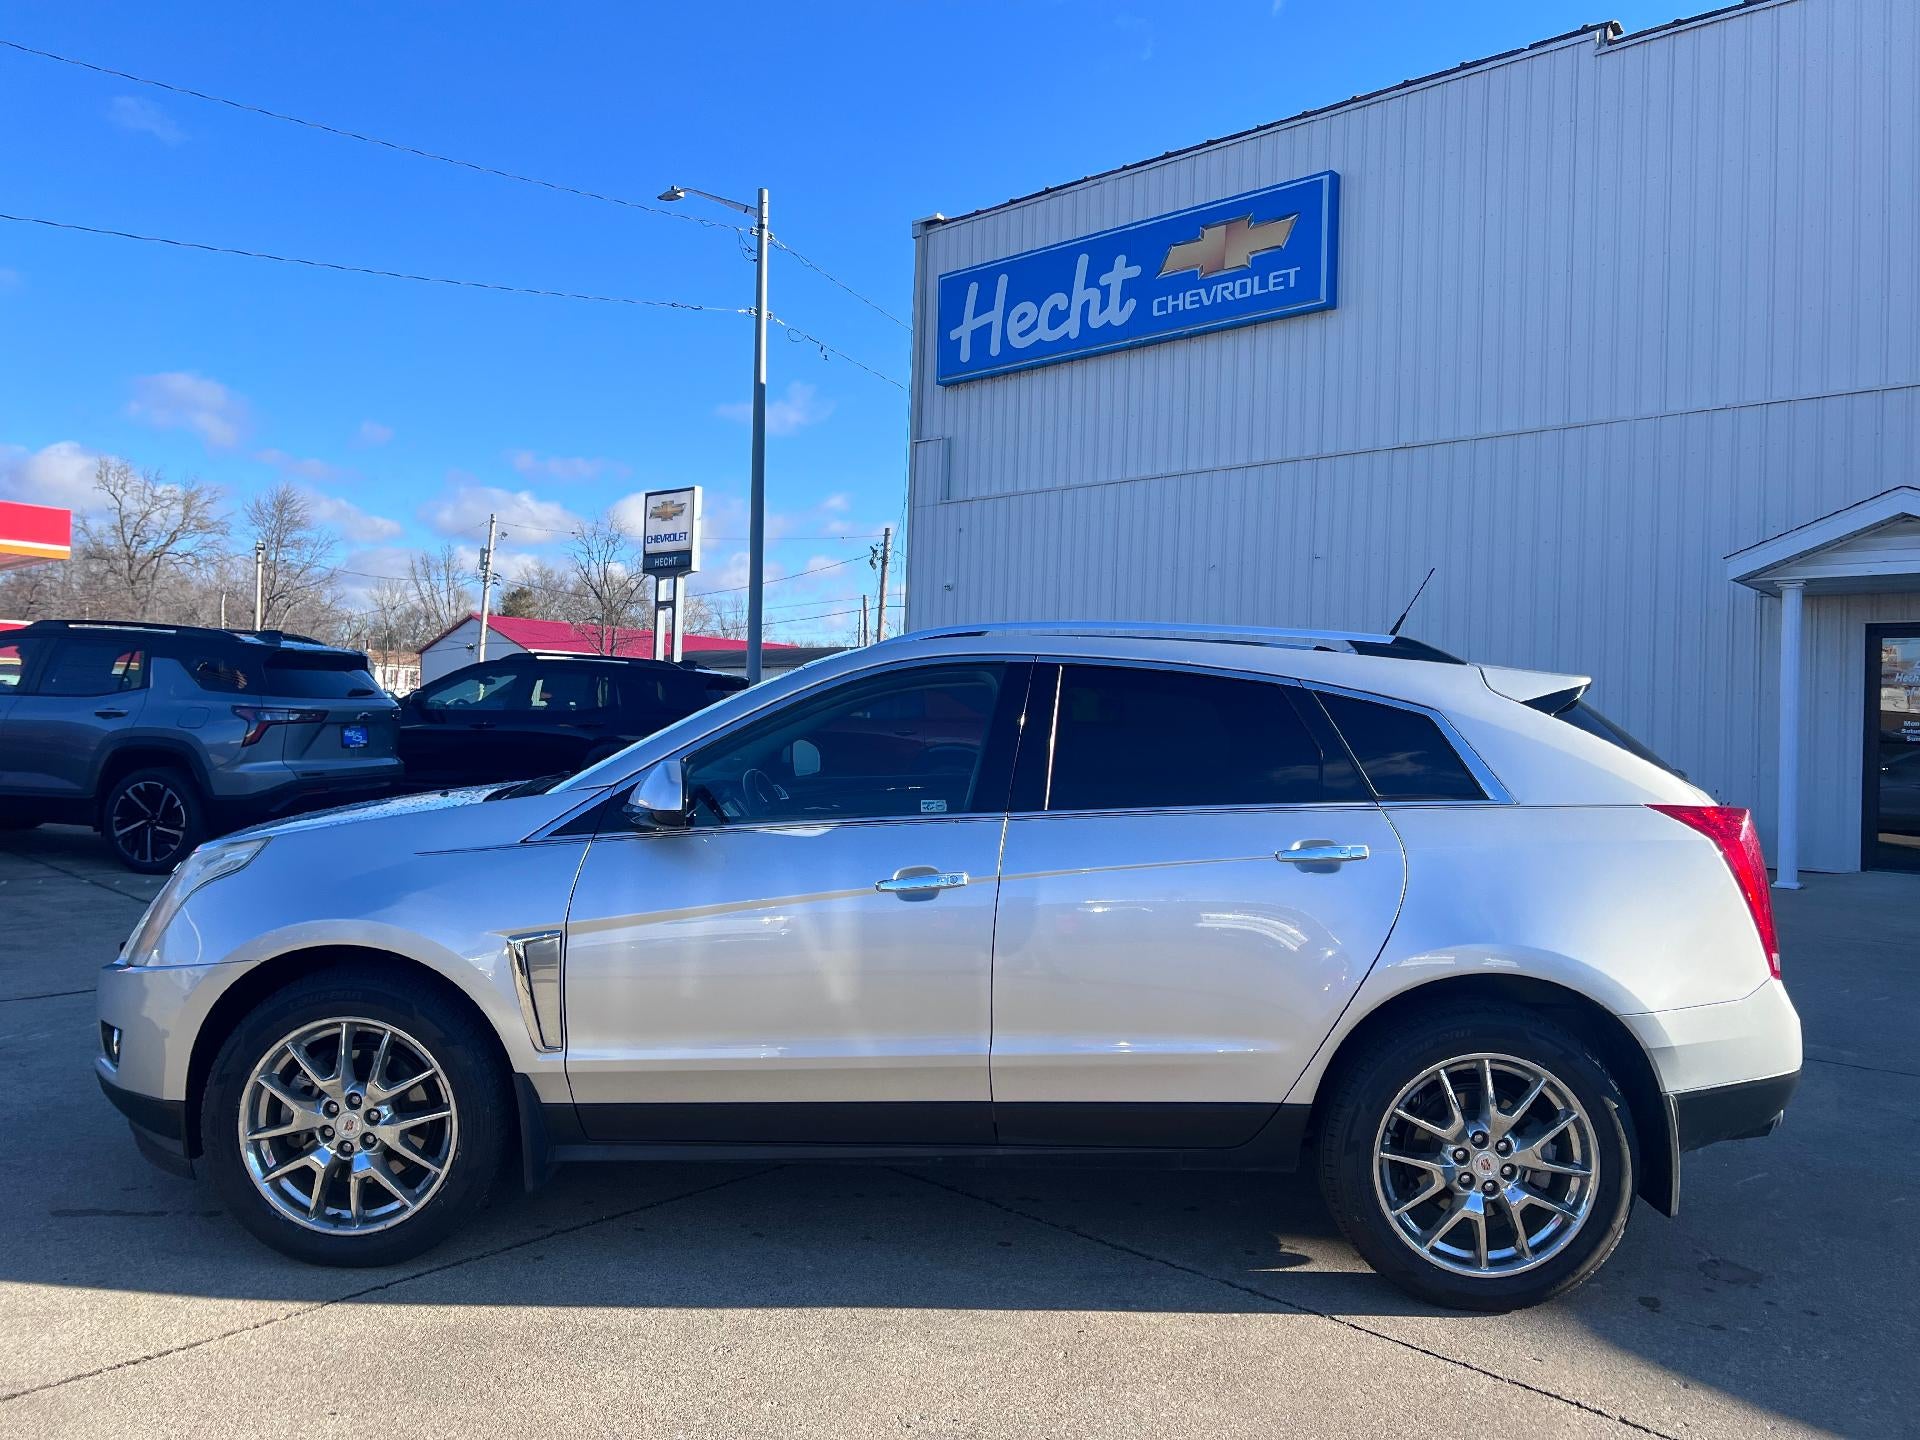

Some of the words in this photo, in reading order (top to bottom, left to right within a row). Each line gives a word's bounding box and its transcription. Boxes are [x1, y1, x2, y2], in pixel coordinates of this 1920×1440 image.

[949, 253, 1142, 363] Hecht
[1152, 266, 1302, 318] CHEVROLET
[646, 532, 688, 544] CHEVROLET
[654, 556, 678, 567] HECHT
